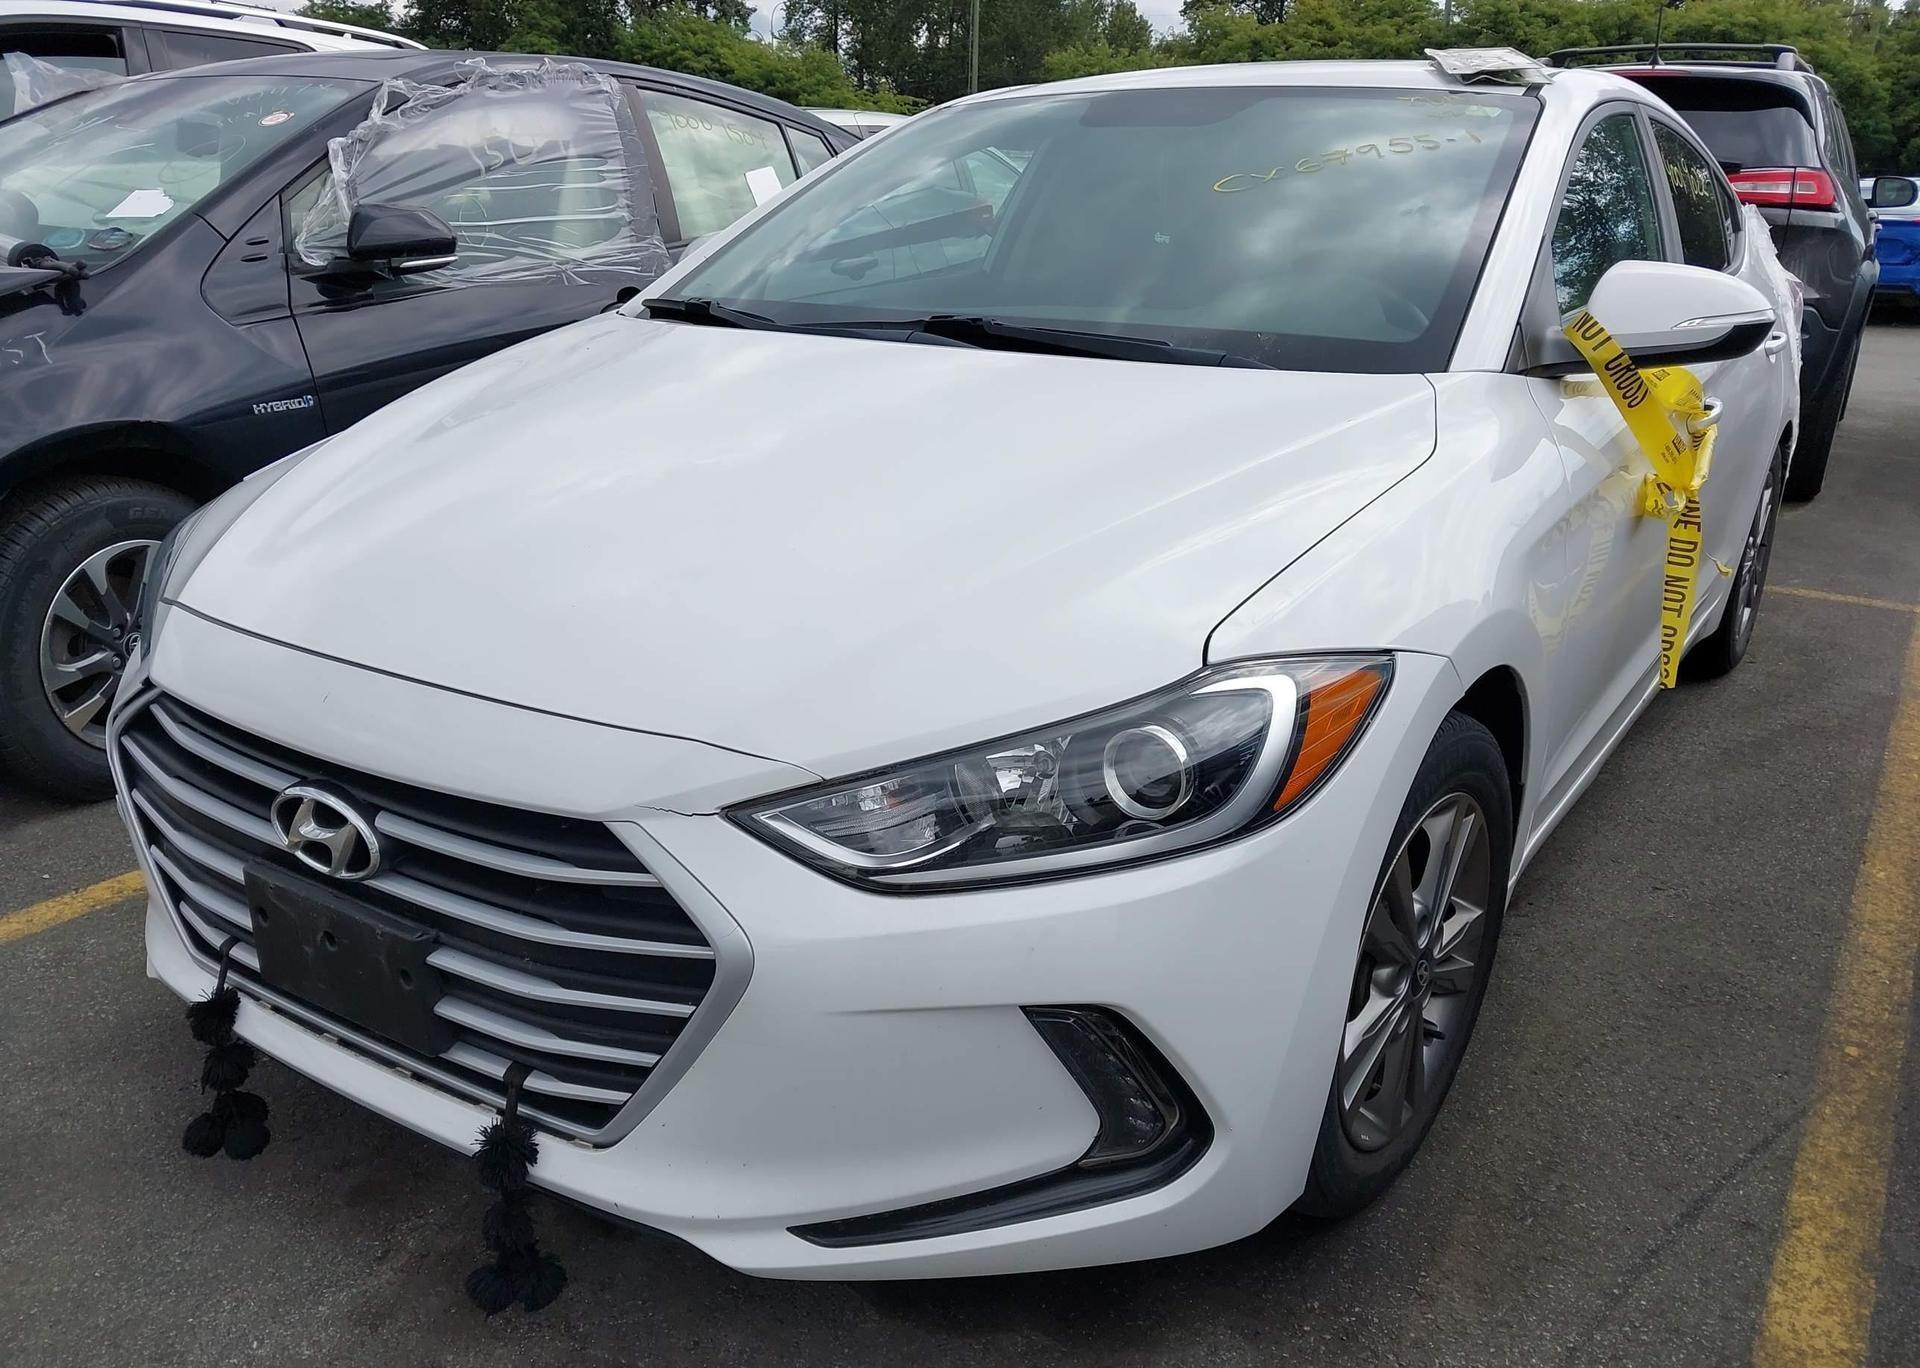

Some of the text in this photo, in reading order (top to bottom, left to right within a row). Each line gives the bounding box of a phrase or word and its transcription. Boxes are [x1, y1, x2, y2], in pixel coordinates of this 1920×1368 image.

[252, 398, 305, 415] HYBRID
[1673, 498, 1701, 533] INE
[1667, 536, 1700, 568] DO
[1663, 574, 1690, 618] NOT
